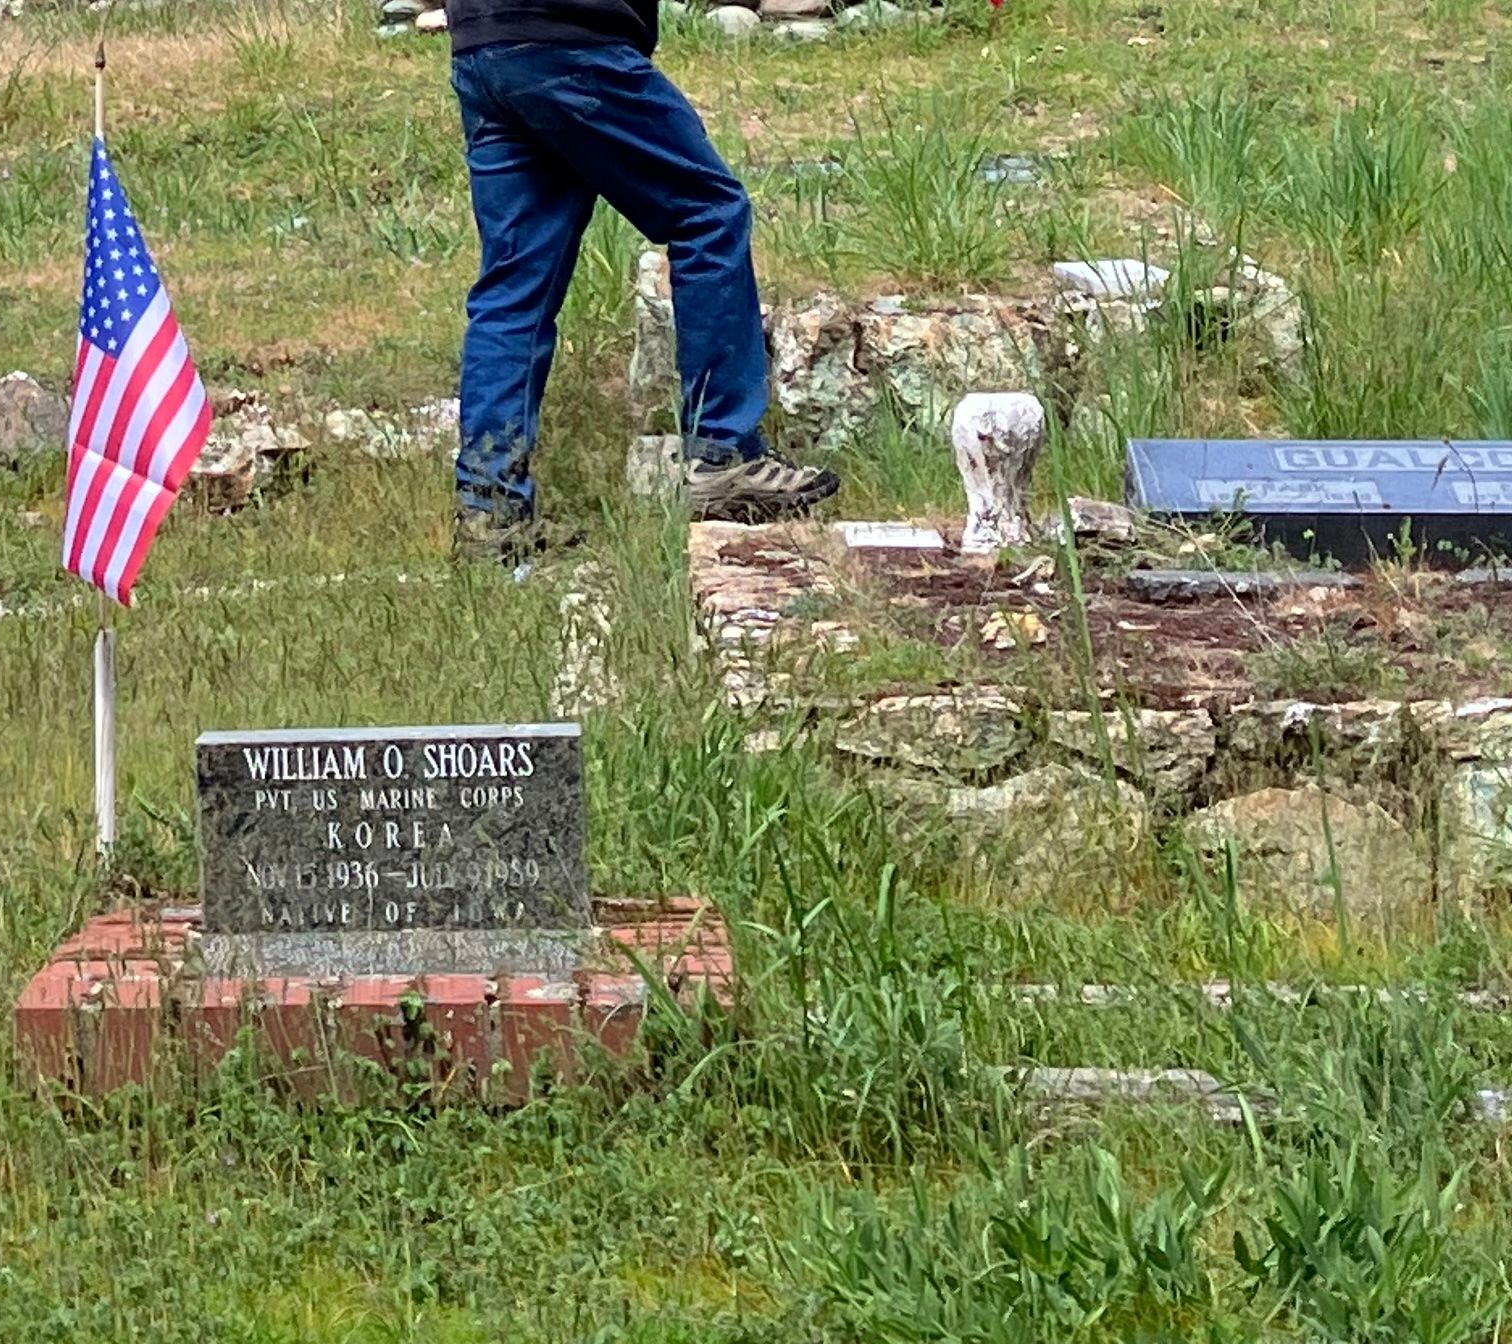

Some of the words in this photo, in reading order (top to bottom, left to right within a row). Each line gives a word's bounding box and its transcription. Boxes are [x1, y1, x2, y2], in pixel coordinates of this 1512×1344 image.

[243, 744, 367, 781] WILLIAM
[423, 742, 536, 780] SHOARS
[254, 789, 292, 812] PVT
[312, 787, 339, 811] US
[359, 786, 438, 811] MARINE
[460, 784, 526, 809] CORPS
[327, 821, 455, 850] KOREA
